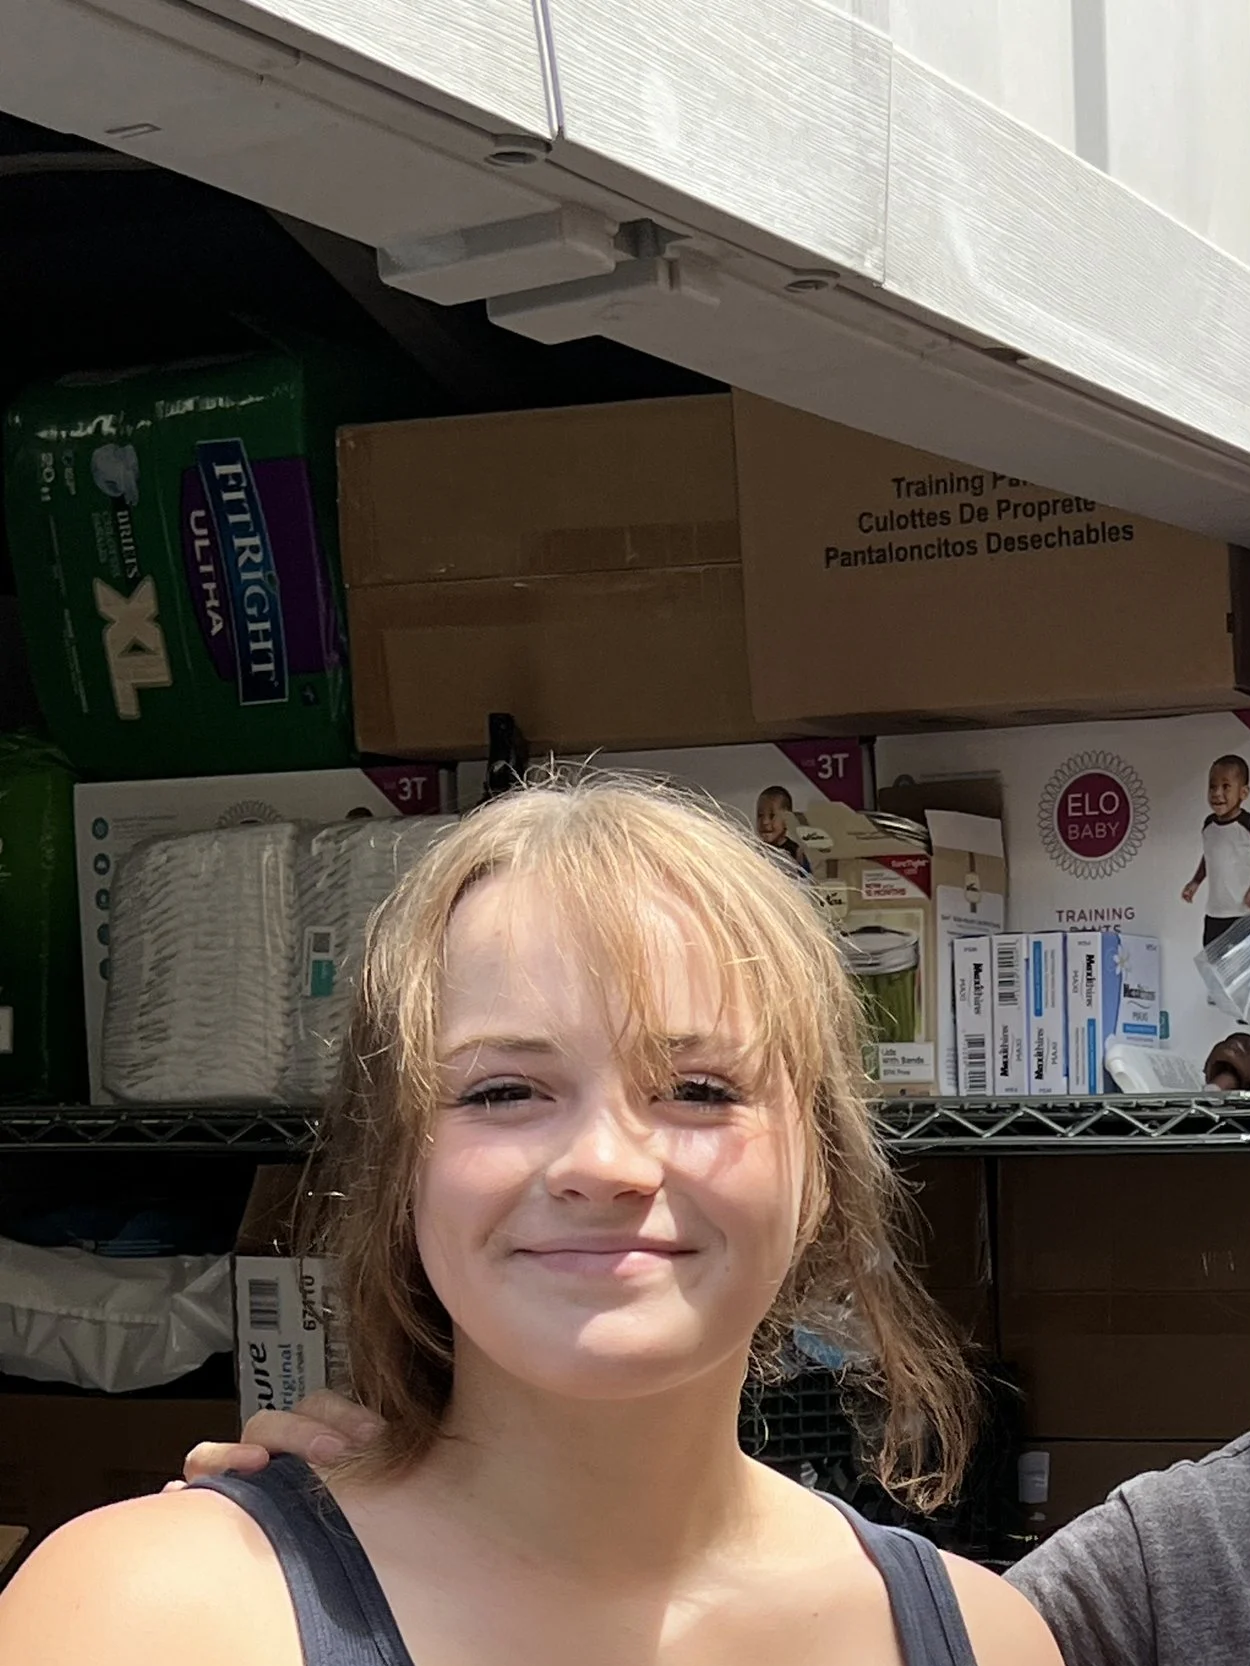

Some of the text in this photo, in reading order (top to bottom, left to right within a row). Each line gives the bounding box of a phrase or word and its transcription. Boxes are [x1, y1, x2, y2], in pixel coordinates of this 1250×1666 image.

[892, 472, 985, 500] Training
[858, 508, 951, 533] Culottes
[959, 501, 988, 525] De
[824, 521, 1134, 569] Pantaloncitos Desechables
[92, 575, 173, 719] XL
[818, 753, 850, 779] 3T
[398, 777, 427, 801] 3T
[1067, 790, 1119, 817] ELO
[1067, 822, 1120, 841] BABY
[1056, 907, 1135, 923] TRAINING
